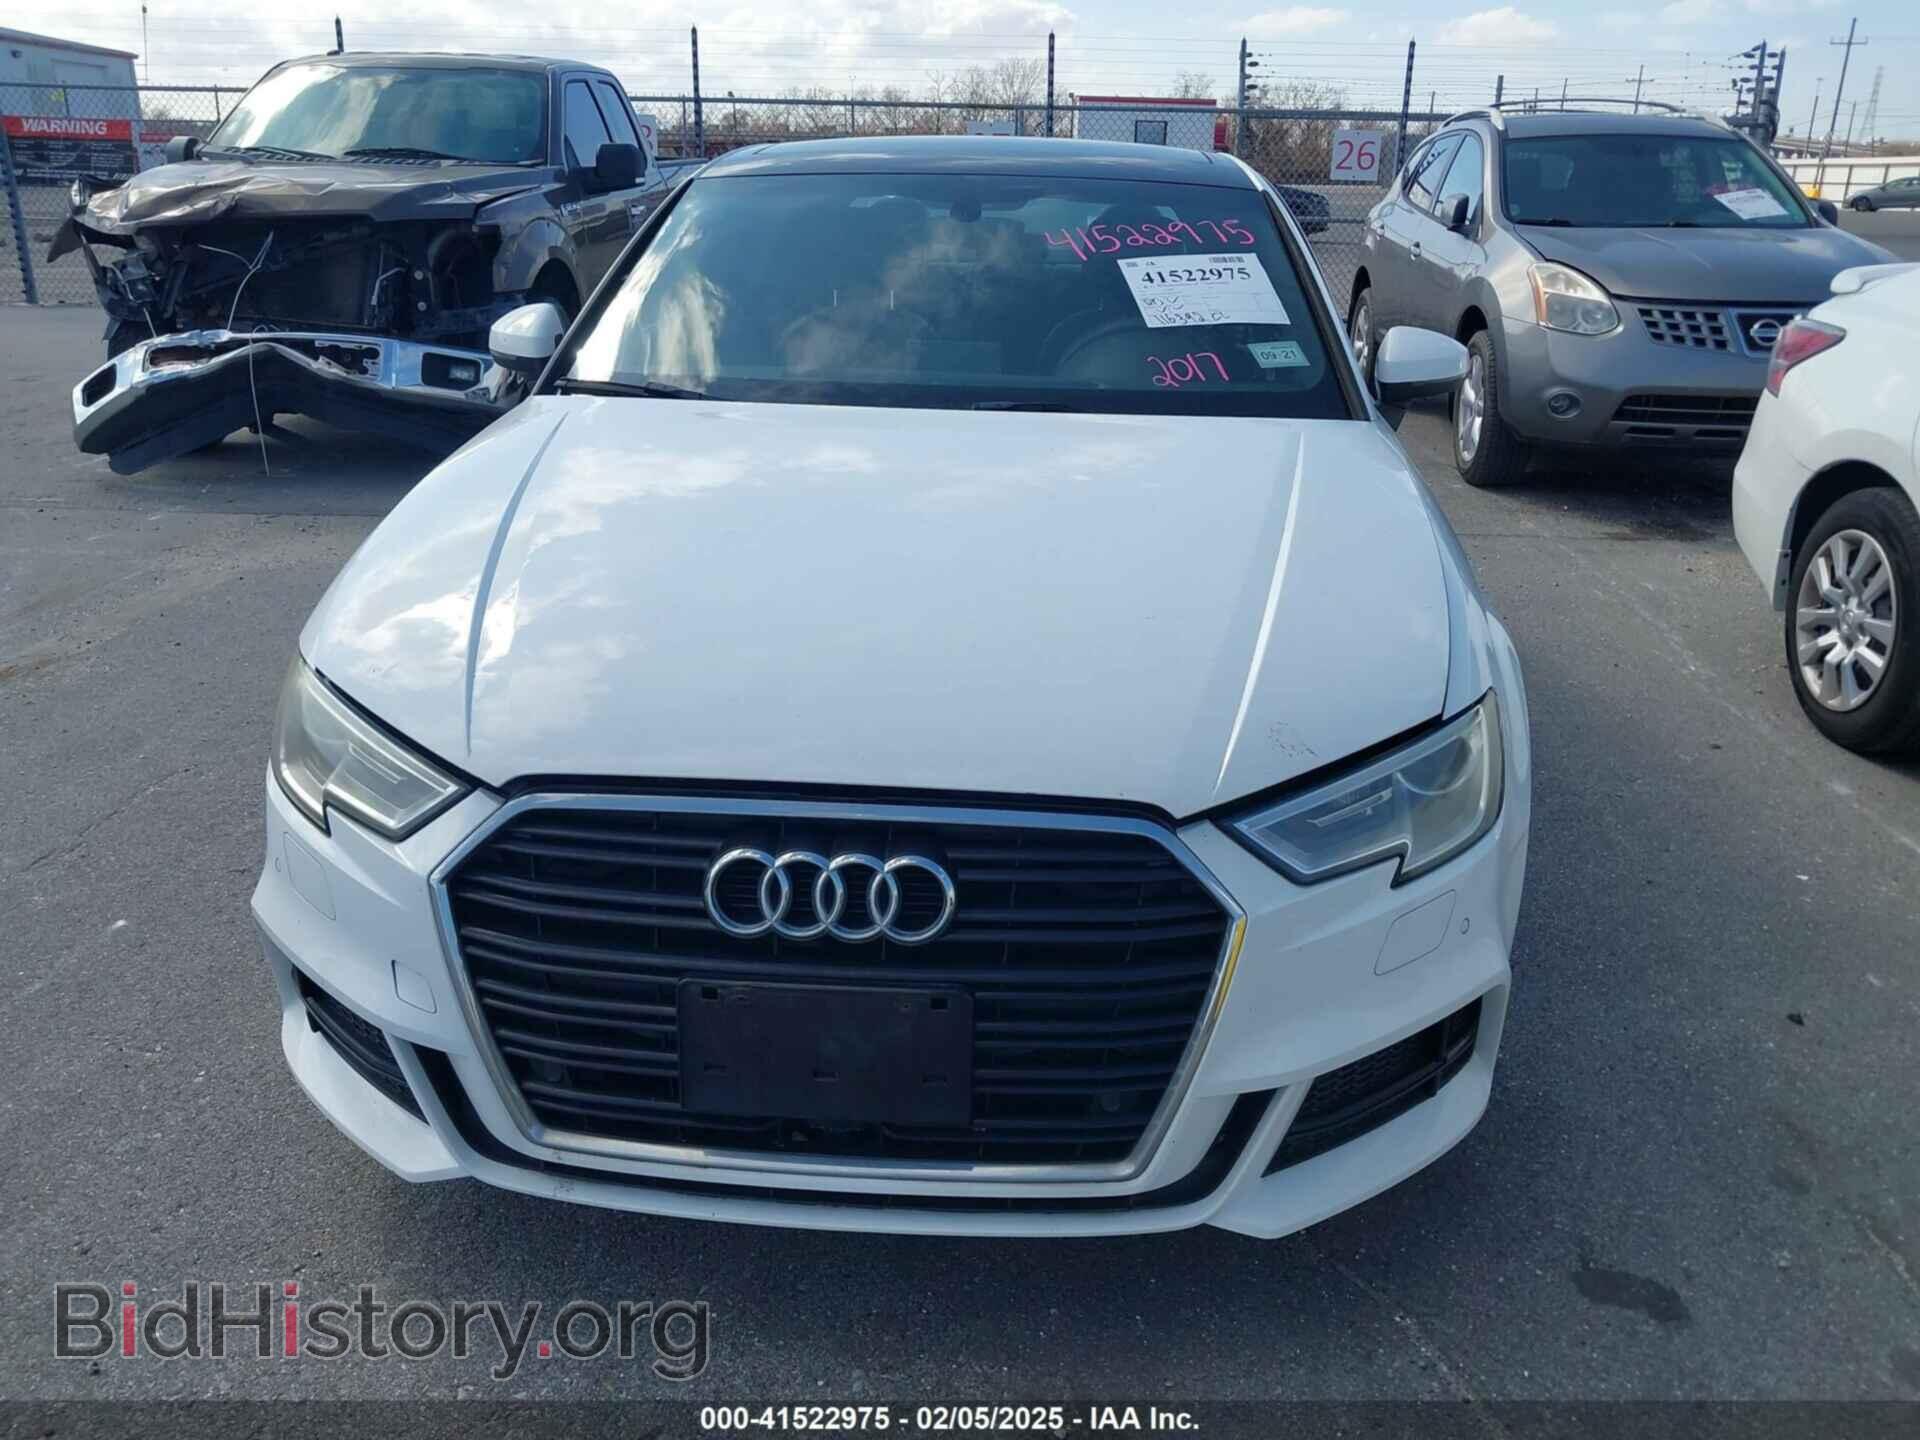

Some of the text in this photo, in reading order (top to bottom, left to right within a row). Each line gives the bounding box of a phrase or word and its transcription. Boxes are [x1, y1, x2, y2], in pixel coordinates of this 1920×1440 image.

[21, 118, 108, 135] WARNING
[1336, 140, 1376, 171] 26
[1044, 219, 1255, 261] 41522975
[1141, 267, 1251, 285] 41522975
[1147, 351, 1230, 388] 2017
